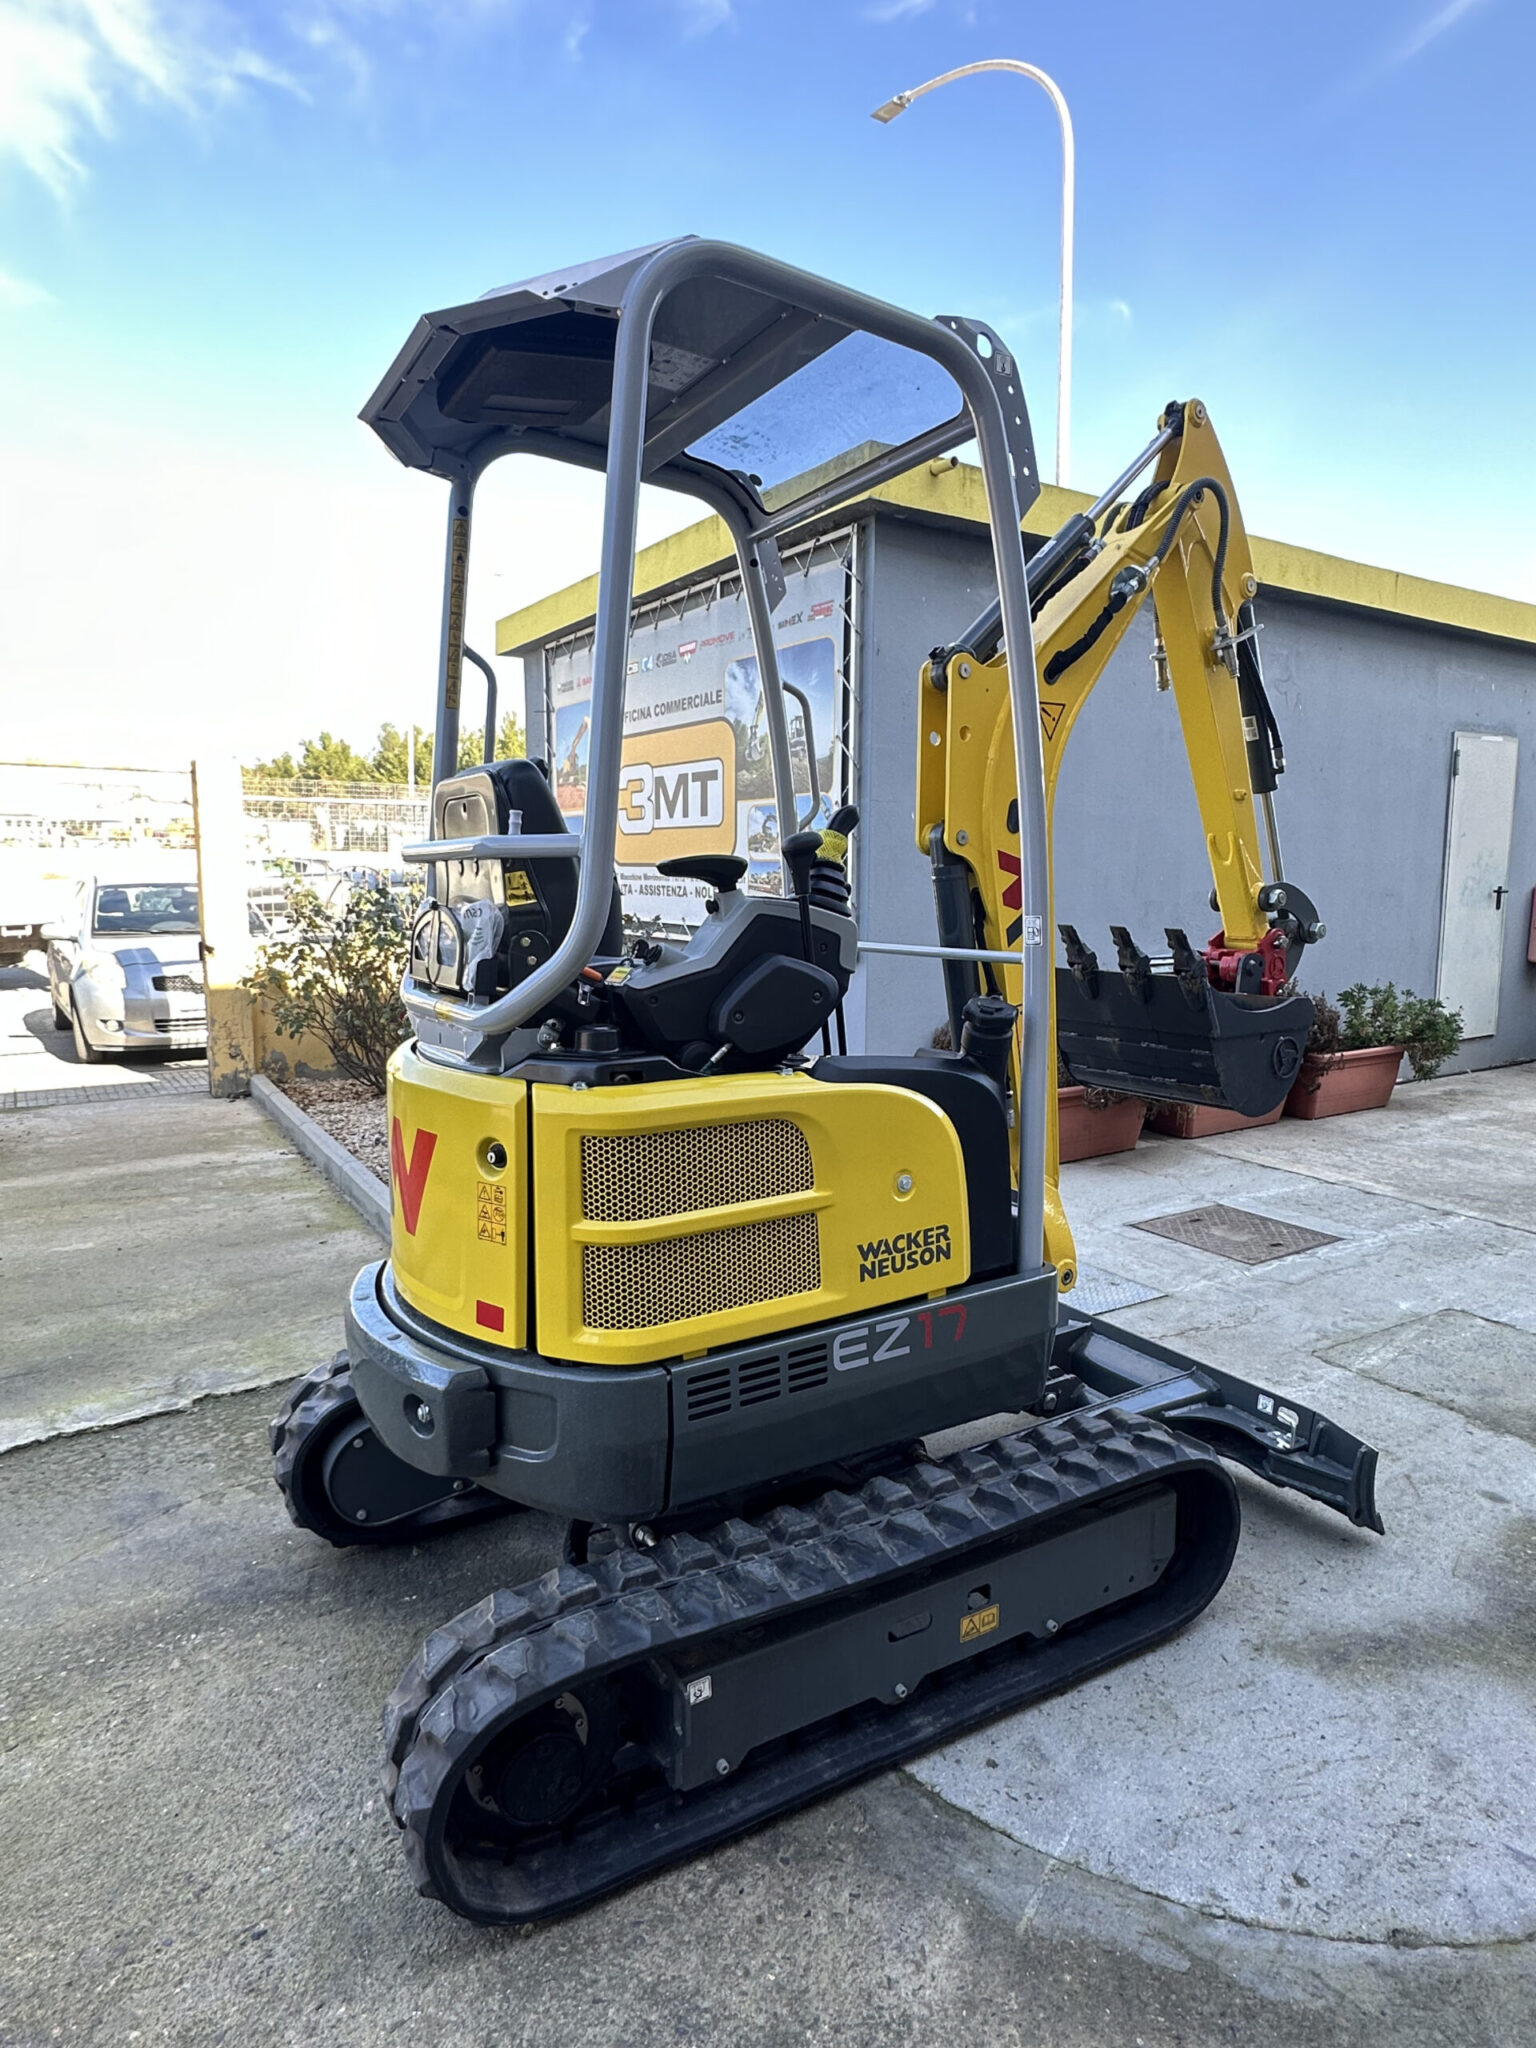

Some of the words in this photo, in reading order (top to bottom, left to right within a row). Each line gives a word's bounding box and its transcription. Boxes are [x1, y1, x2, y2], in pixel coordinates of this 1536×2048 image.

[624, 705, 652, 723] FICINA
[654, 689, 722, 717] COMMERCIALE
[618, 762, 719, 835] 3MT
[639, 884, 688, 898] ASSISTENZA
[857, 1224, 951, 1262] WACKER
[859, 1242, 951, 1283] NEUSON
